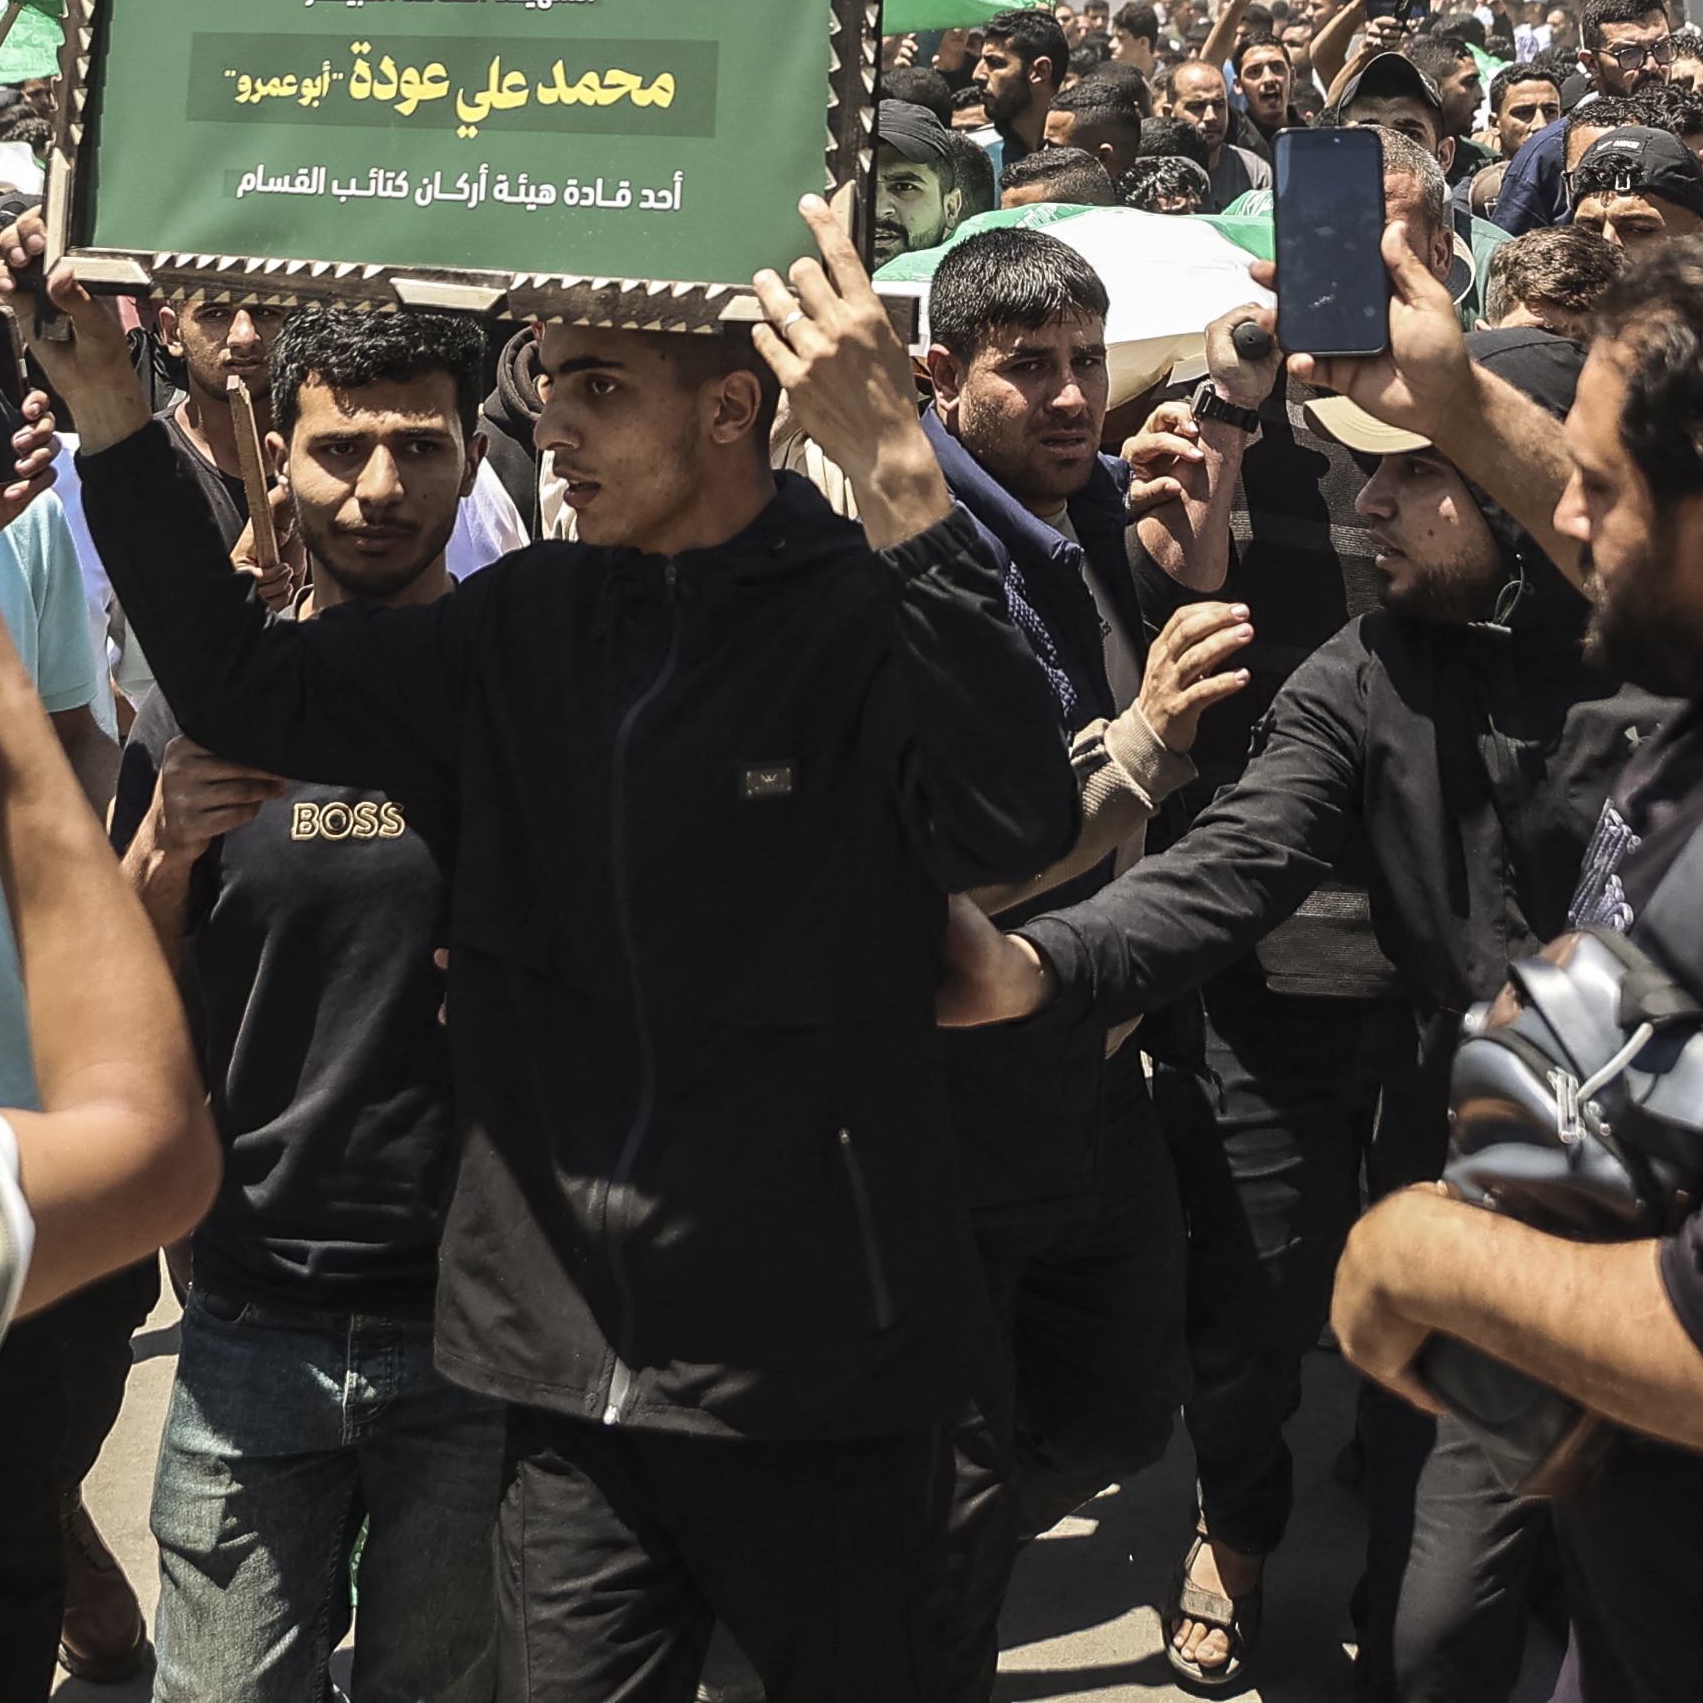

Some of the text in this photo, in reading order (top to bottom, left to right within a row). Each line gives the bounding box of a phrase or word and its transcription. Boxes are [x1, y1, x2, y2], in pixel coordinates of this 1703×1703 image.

[348, 40, 451, 117] عودة
[455, 54, 531, 140] علي
[535, 58, 677, 109] محمد
[235, 162, 685, 212] أحد قادة هيئة أركان كتائب القسام
[291, 801, 406, 840] BOSS
